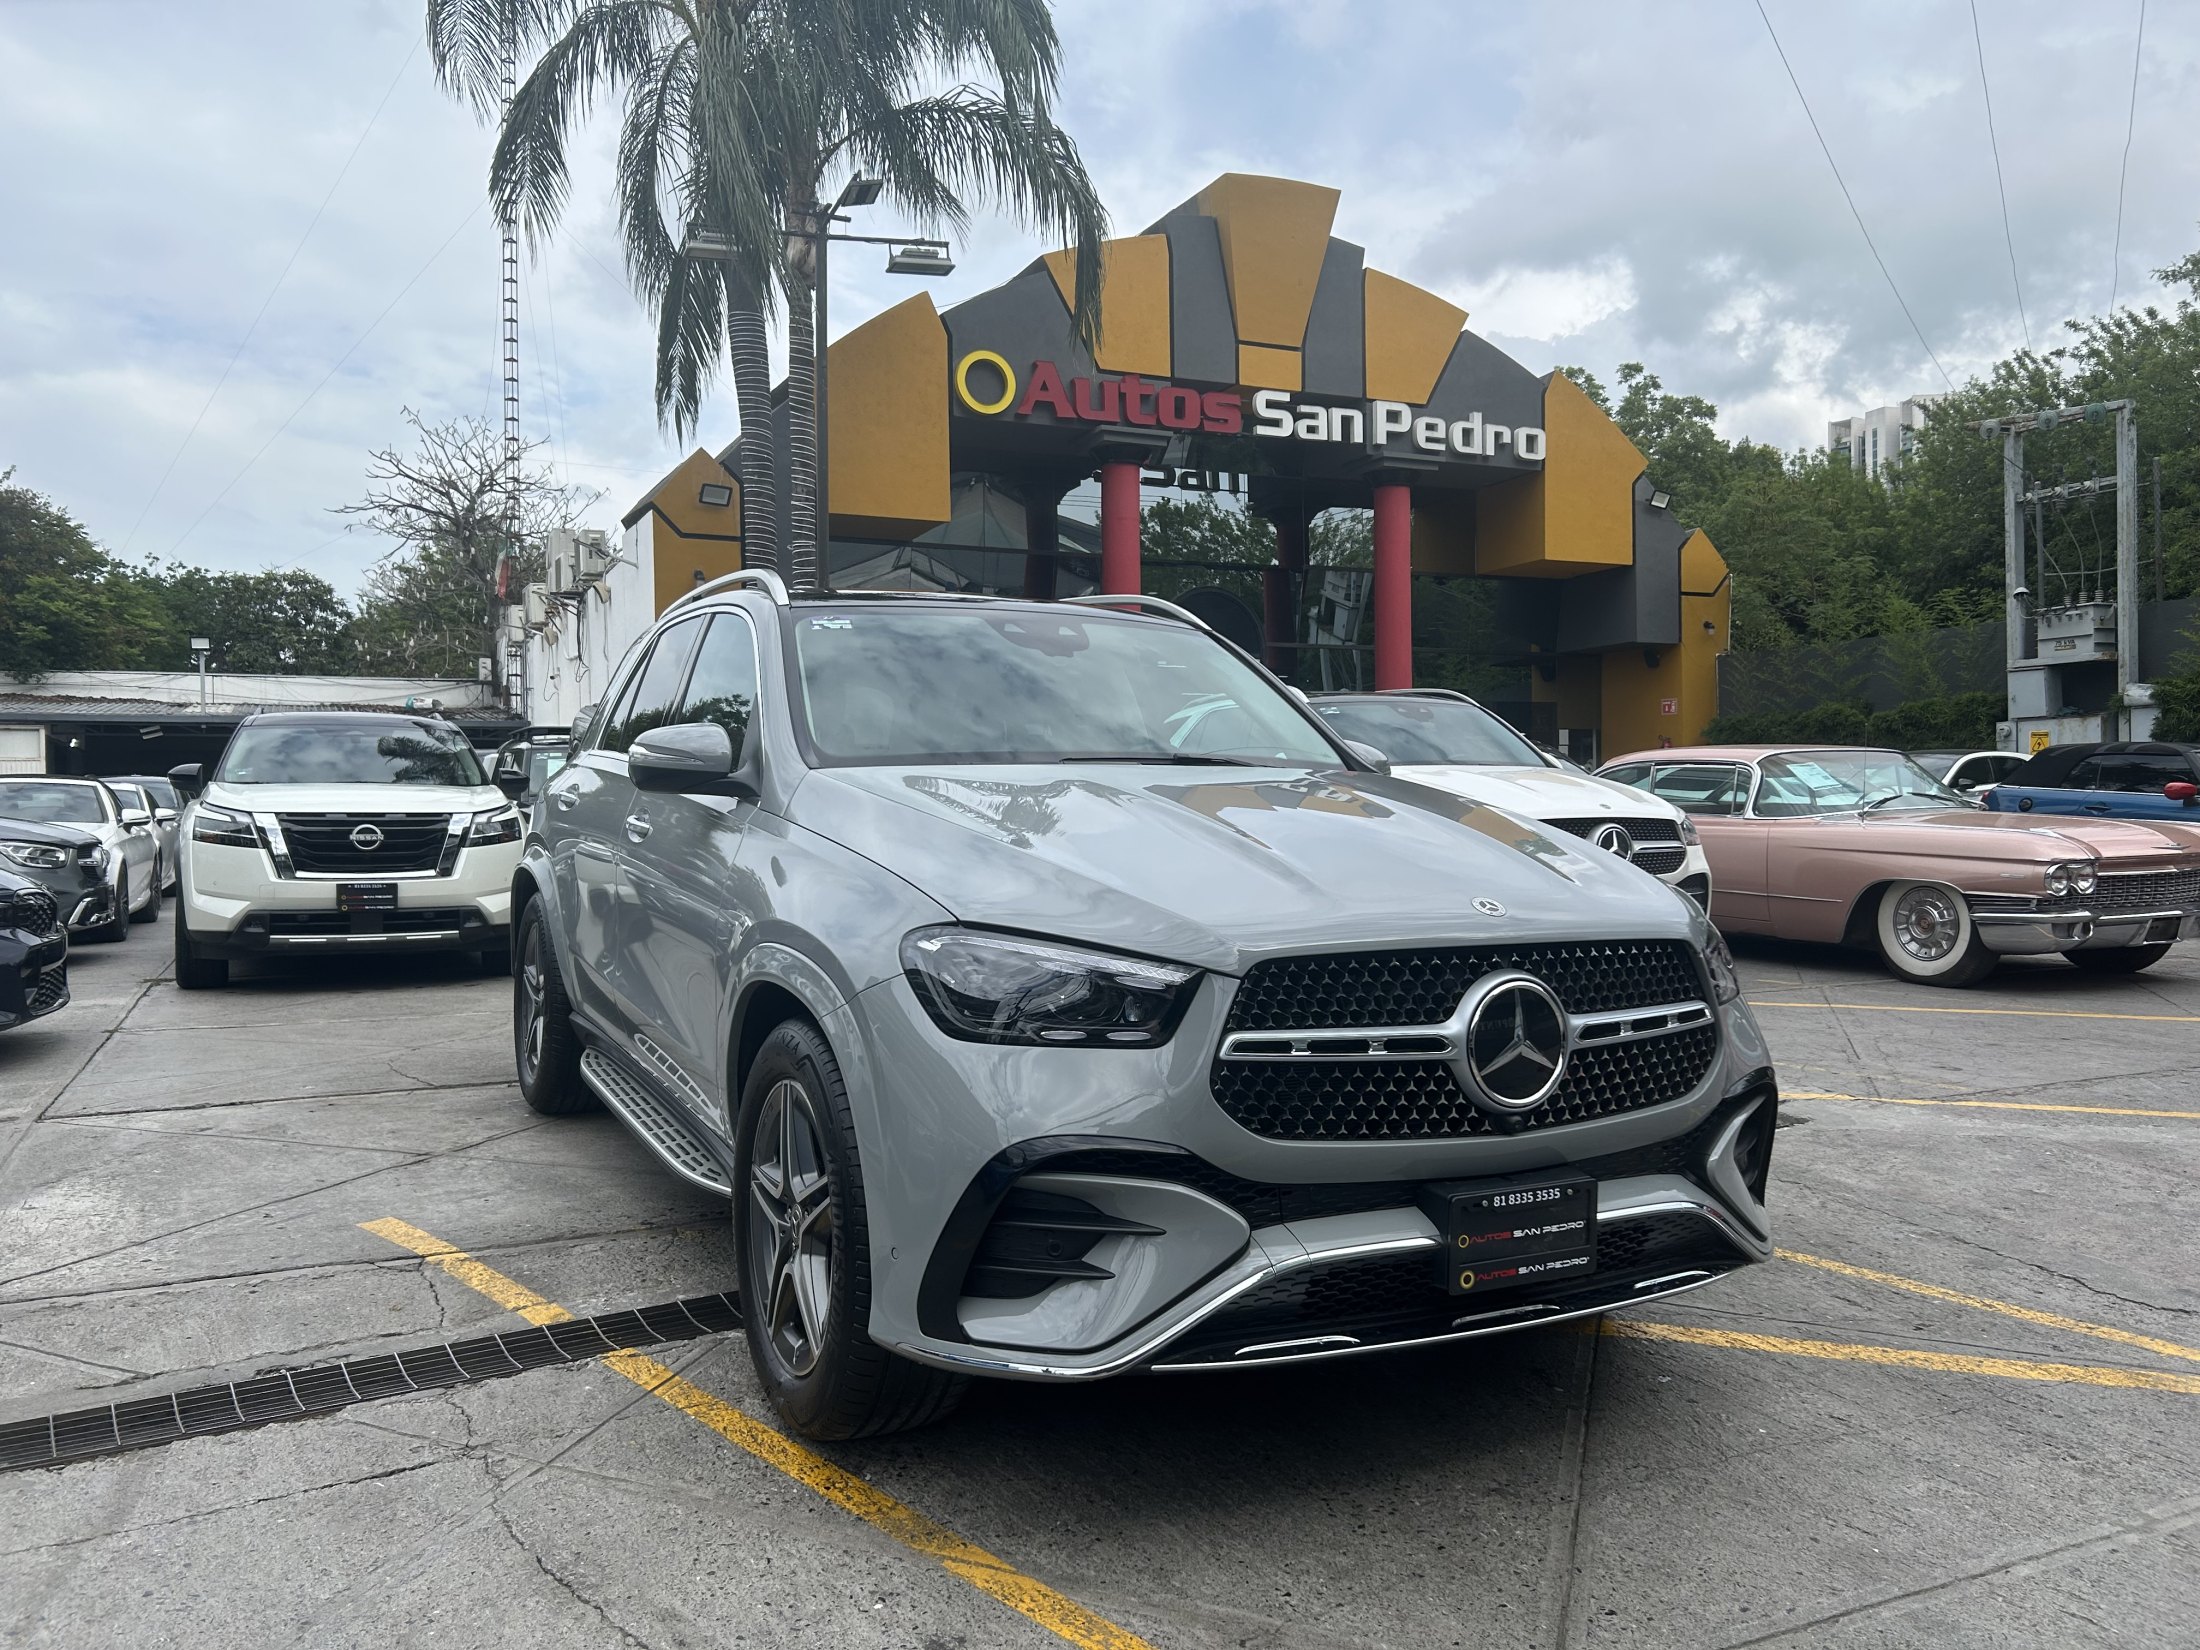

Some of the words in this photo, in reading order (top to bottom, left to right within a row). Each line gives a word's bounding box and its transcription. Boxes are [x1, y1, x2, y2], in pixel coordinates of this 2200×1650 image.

[1016, 360, 1243, 434] Autos
[1493, 1195, 1507, 1207] 81
[1508, 1191, 1534, 1205] 8335
[1535, 1188, 1561, 1202] 3535
[1470, 1231, 1512, 1244] AUTOS
[1513, 1227, 1541, 1238] SAN
[1476, 1268, 1517, 1280] AUTOS
[1518, 1263, 1545, 1275] SAN
